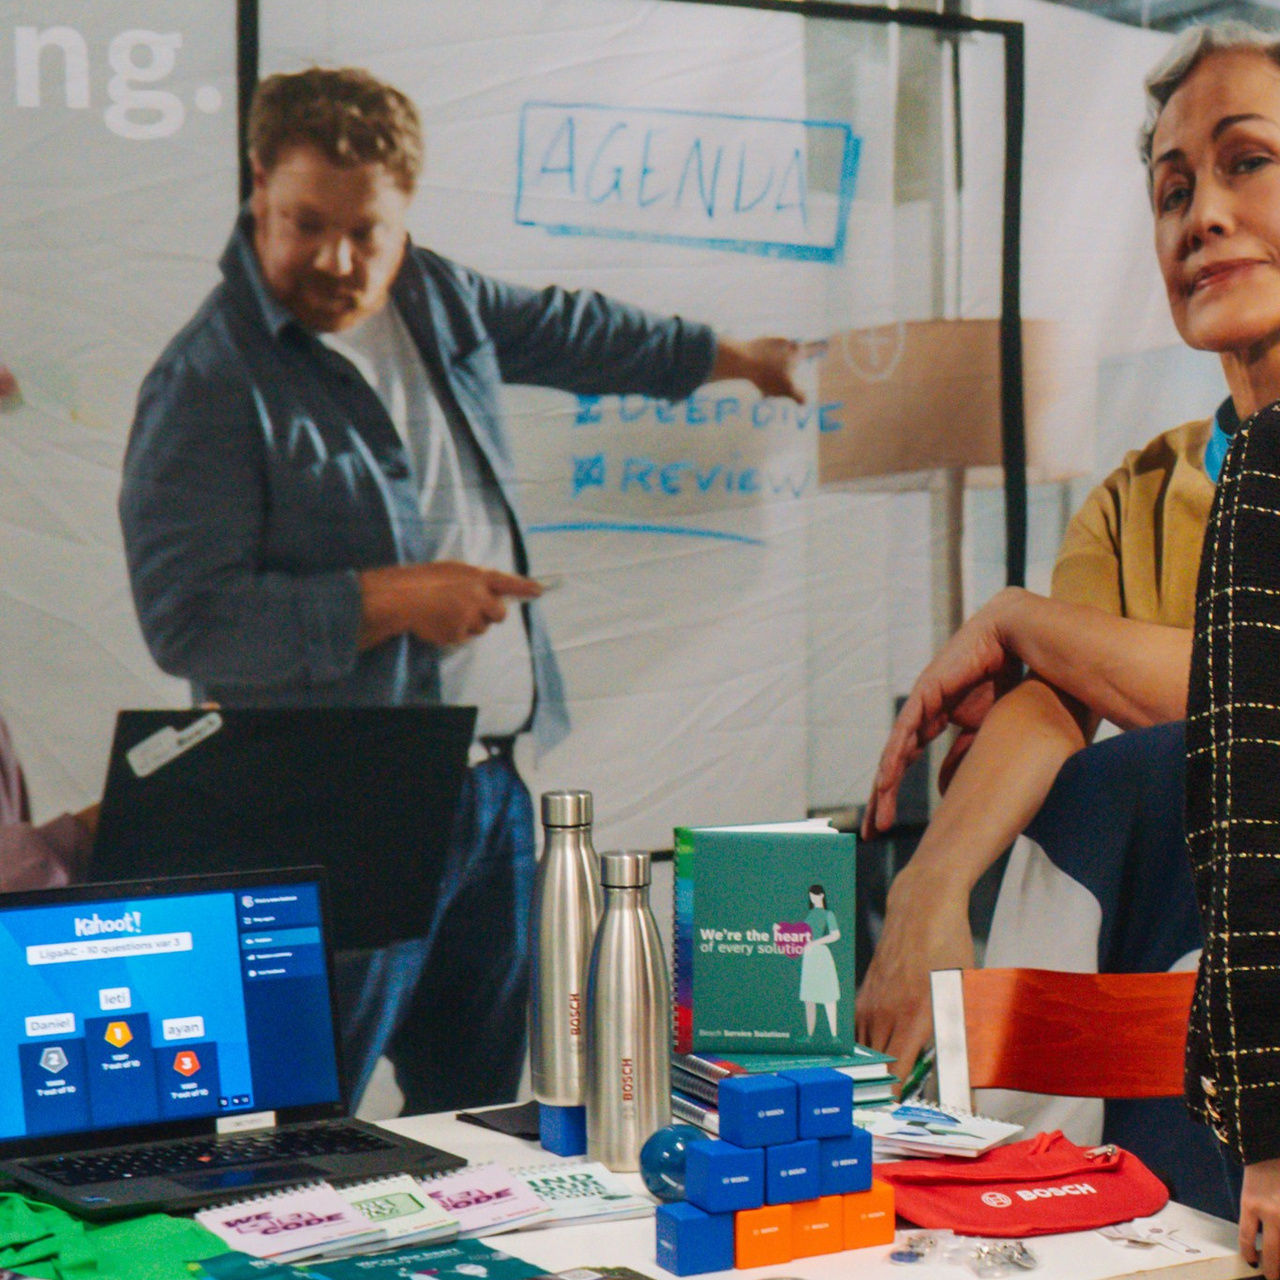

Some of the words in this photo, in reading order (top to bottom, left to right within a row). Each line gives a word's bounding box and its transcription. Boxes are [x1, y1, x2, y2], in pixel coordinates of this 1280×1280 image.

[540, 116, 807, 226] AGENDA
[74, 911, 142, 937] Kahoot!
[700, 928, 742, 941] We're
[746, 929, 769, 941] the
[773, 925, 812, 942] heart
[101, 941, 153, 955] questions
[156, 939, 172, 949] var
[700, 941, 713, 953] of
[718, 944, 753, 956] every
[569, 993, 581, 1036] BOSCH
[30, 1018, 71, 1032] Daniel
[167, 1023, 200, 1037] ayan
[113, 1028, 123, 1041] 1
[48, 1053, 60, 1066] 2
[181, 1057, 192, 1070] 3
[621, 1058, 633, 1101] BOSCH
[526, 1173, 594, 1188] IND
[442, 1187, 513, 1213] ODE
[1015, 1183, 1098, 1201] BOSCH
[260, 1211, 345, 1236] CODE
